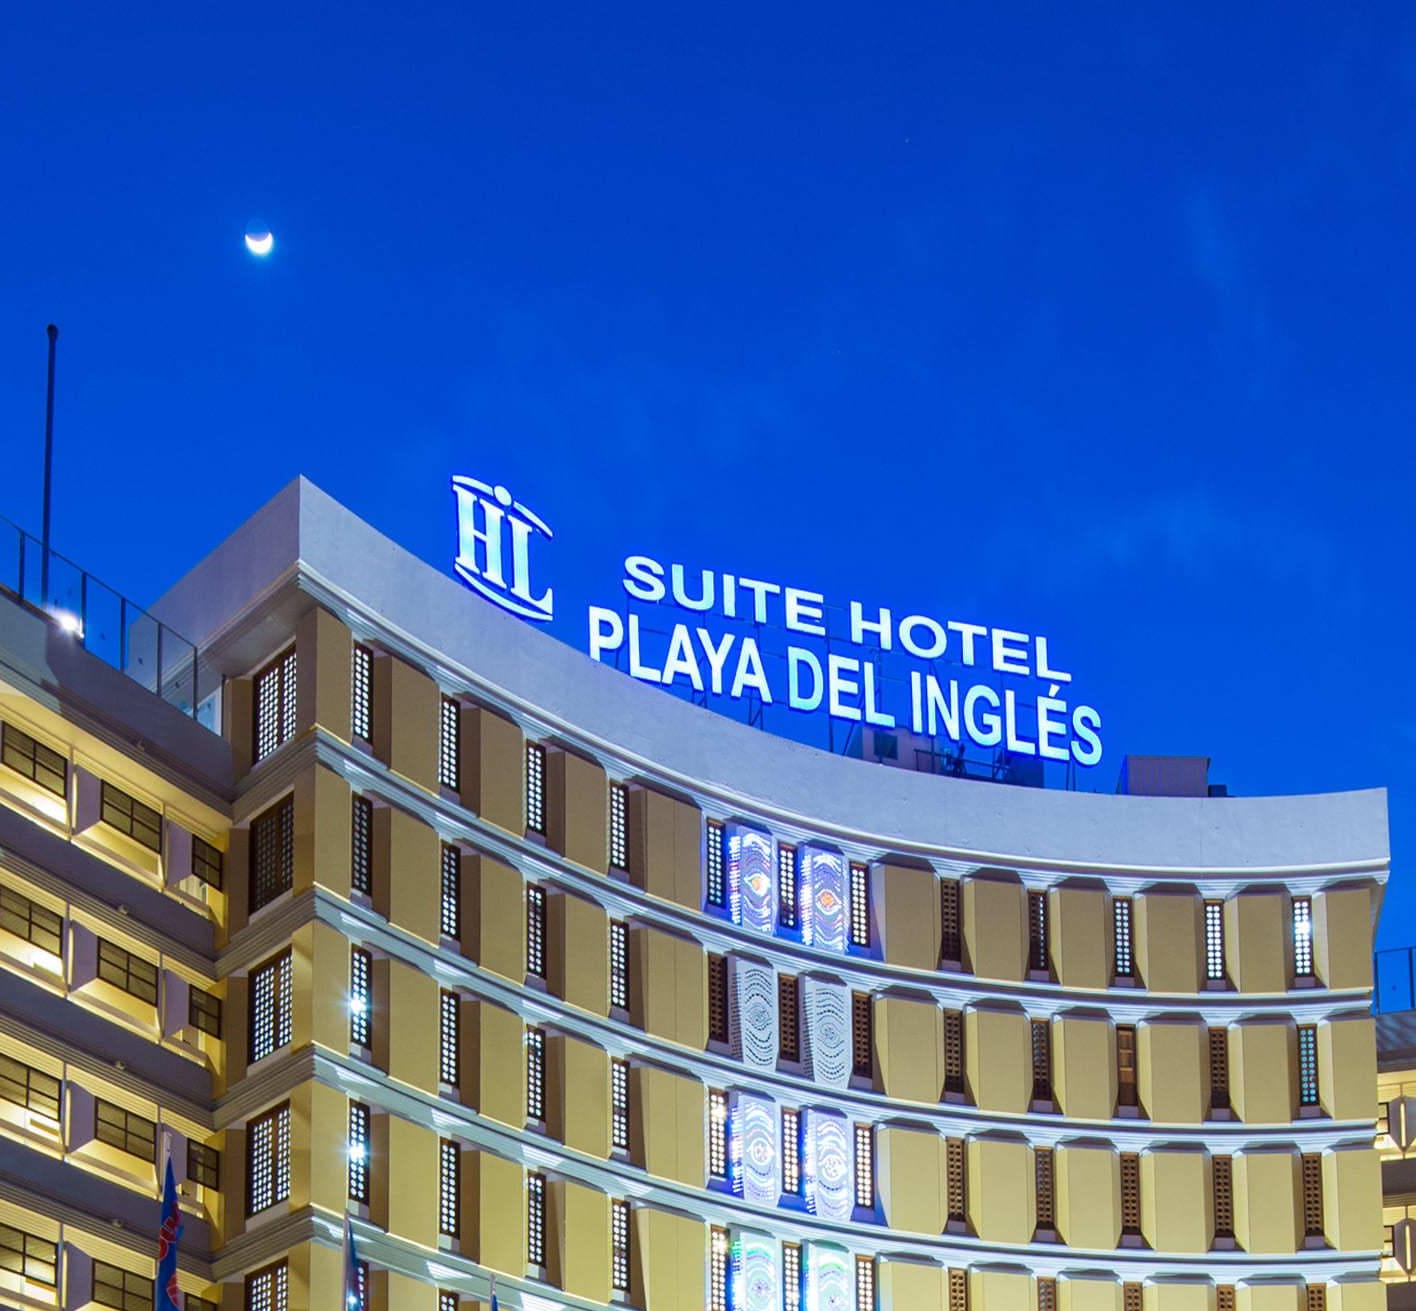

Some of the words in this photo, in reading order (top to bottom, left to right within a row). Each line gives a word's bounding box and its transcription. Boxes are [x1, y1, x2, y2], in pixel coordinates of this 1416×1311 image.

[588, 605, 772, 703] PLAYA
[787, 645, 896, 728] DEL
[910, 670, 1104, 766] INGLÉS
[623, 555, 826, 637] SUITE
[850, 600, 1072, 682] HOTEL
